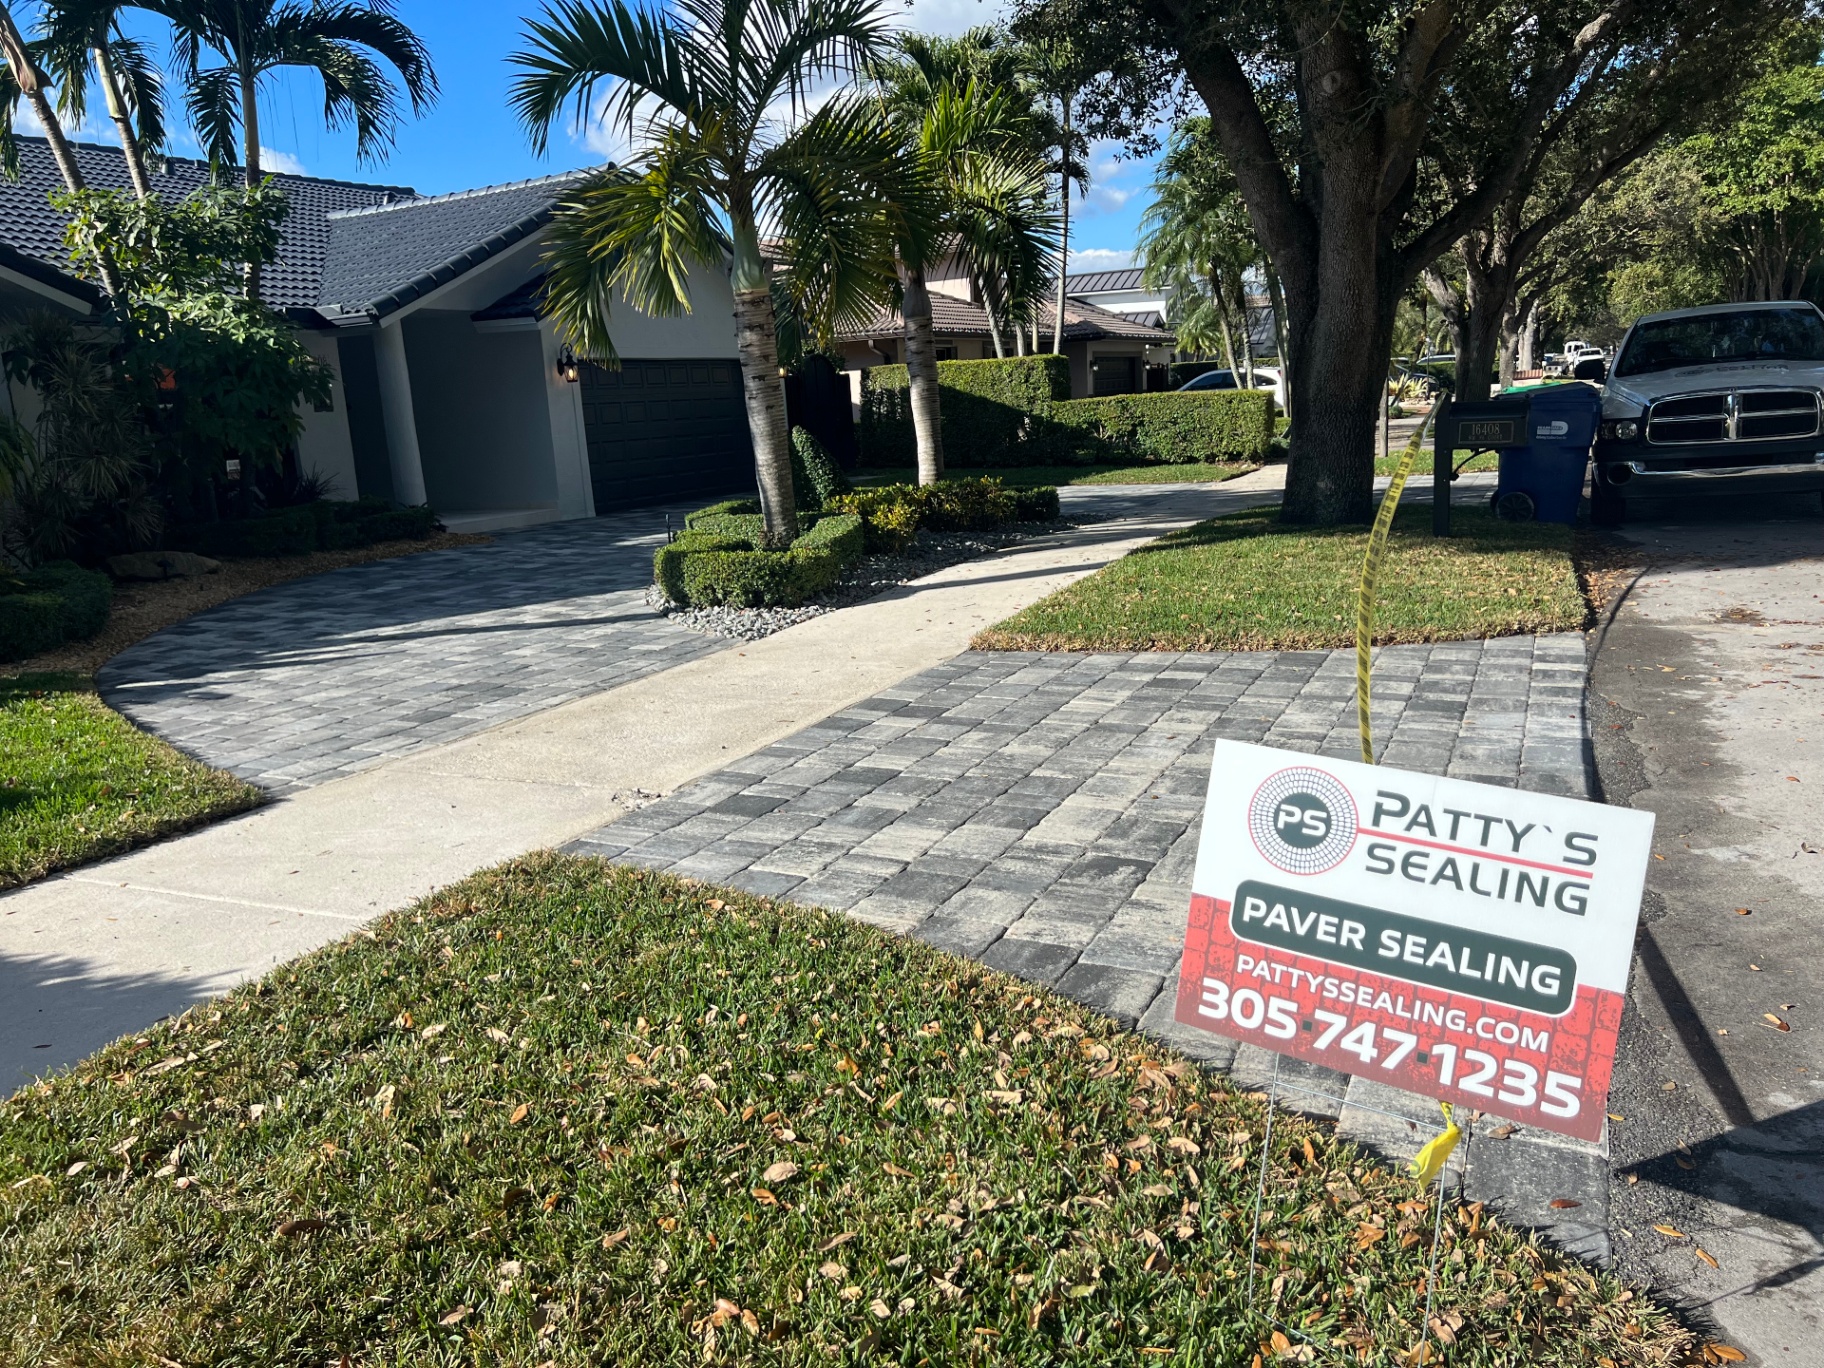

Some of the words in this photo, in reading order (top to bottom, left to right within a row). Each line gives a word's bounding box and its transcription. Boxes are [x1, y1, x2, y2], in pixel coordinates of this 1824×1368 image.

[1472, 423, 1500, 435] 16408
[1277, 803, 1328, 837] PS
[1365, 843, 1590, 917] SEALING
[1242, 896, 1366, 951] PAVER
[1378, 929, 1562, 997] SEALING
[1236, 954, 1550, 1054] PATTYSSEALING.COM
